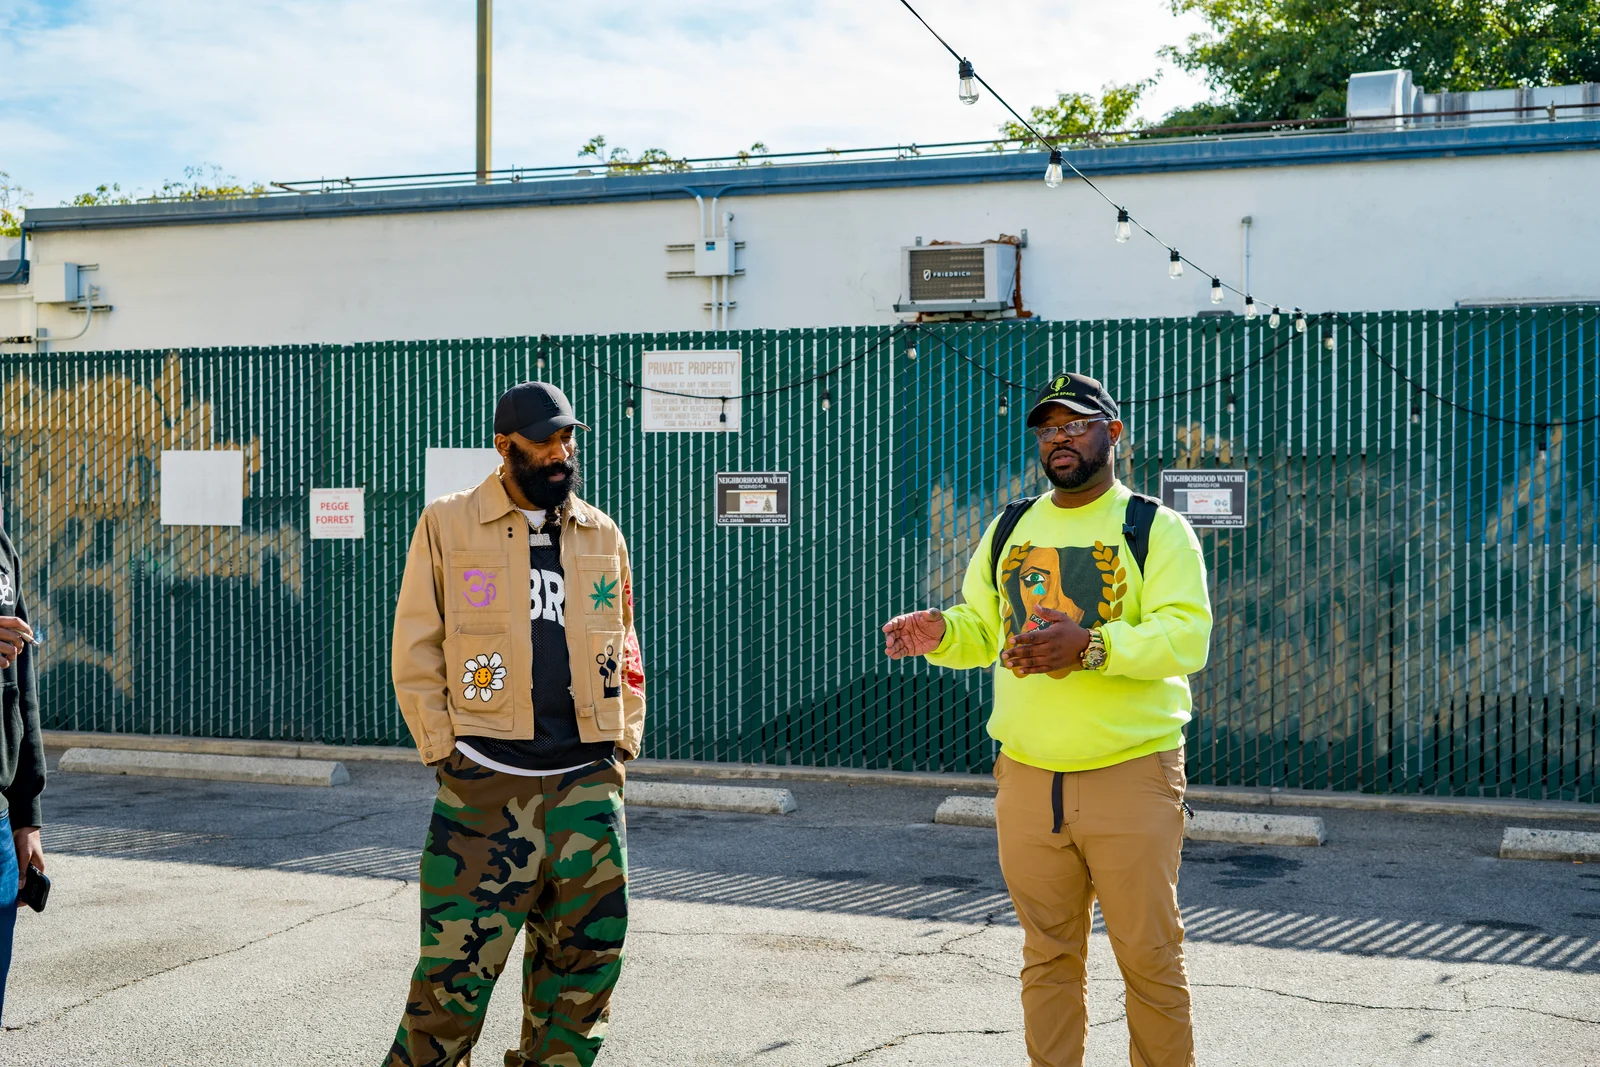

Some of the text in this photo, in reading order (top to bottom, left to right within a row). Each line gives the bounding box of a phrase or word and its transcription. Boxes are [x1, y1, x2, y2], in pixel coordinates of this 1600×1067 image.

[648, 361, 736, 375] PRIVATE PROPERTY
[719, 476, 787, 484] NEIGHBORHOOD WATCHE
[1164, 474, 1244, 483] NEIGHBORHOOD WATCHE
[320, 502, 350, 511] PEGGE
[316, 515, 355, 525] FORREST
